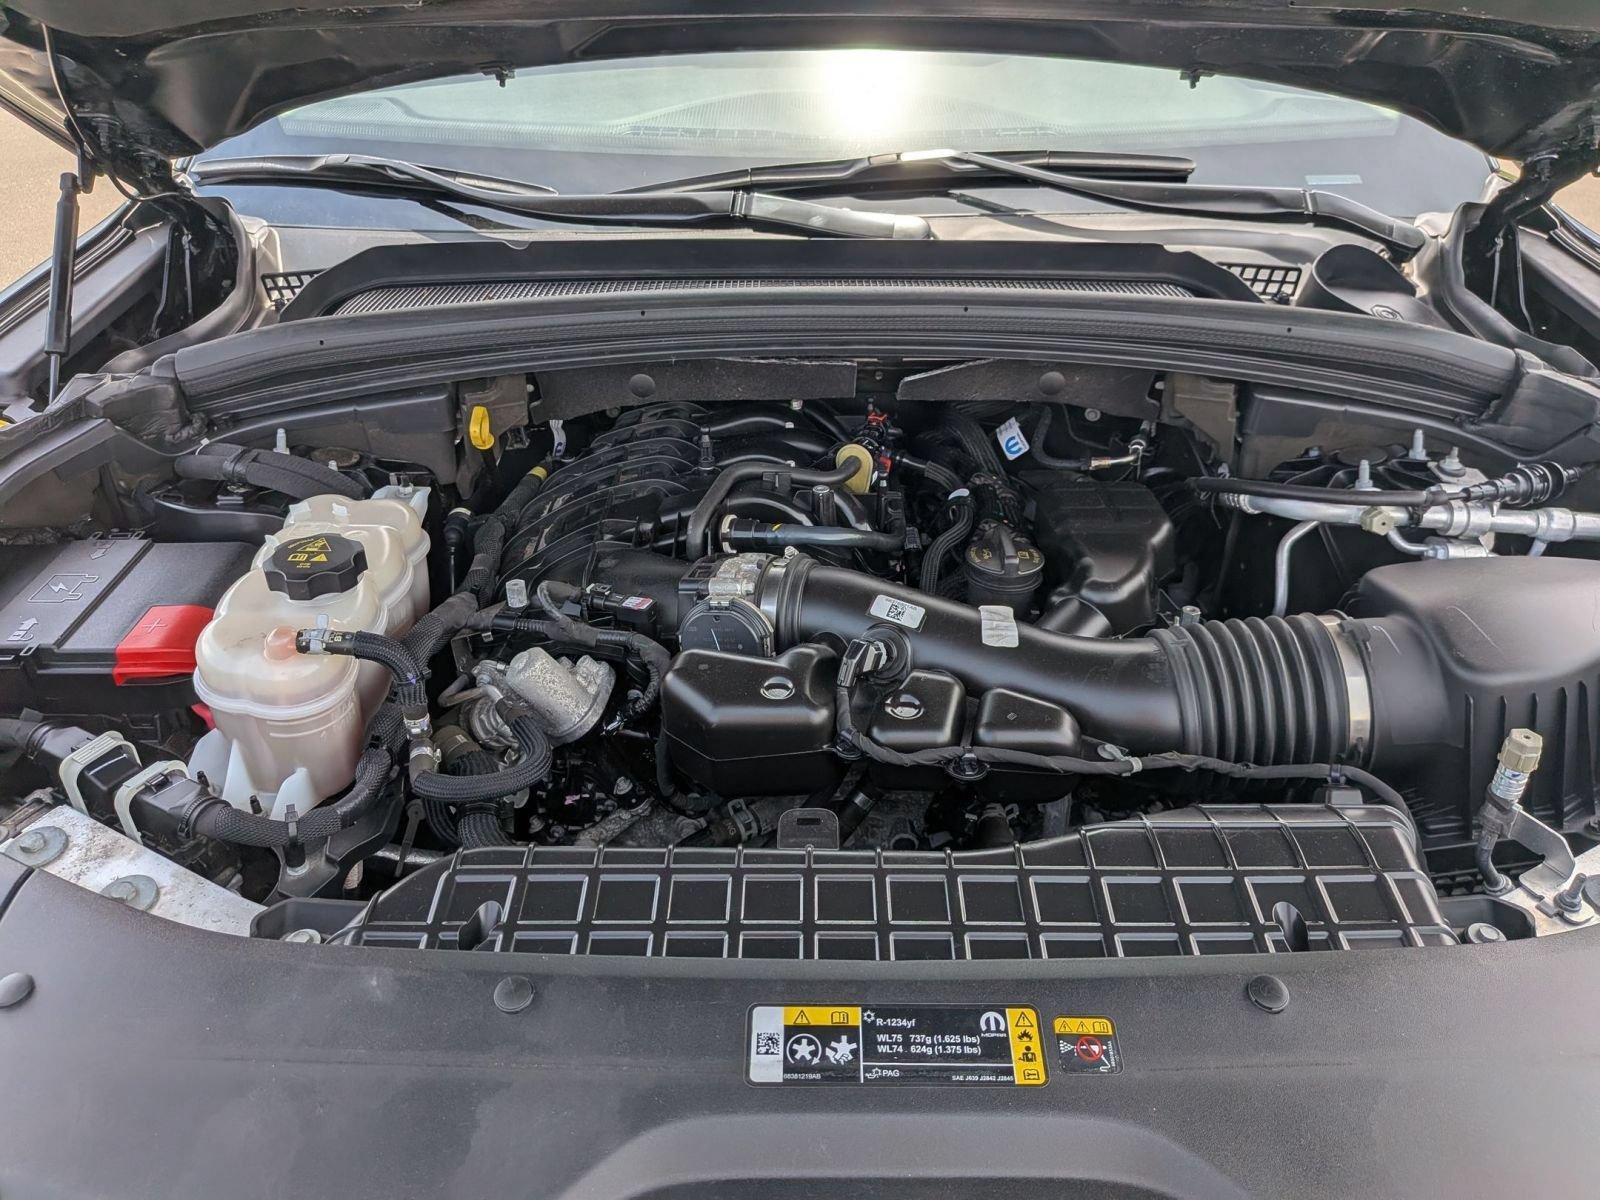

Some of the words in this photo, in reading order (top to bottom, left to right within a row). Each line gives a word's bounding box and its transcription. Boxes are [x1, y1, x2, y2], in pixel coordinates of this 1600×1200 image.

[876, 1018, 916, 1029] R-1234yf
[877, 1034, 903, 1043] WL75
[909, 1034, 932, 1045] 737g
[933, 1034, 961, 1044] (1.625
[962, 1034, 981, 1045] lbs)
[877, 1045, 903, 1053] WL74
[910, 1045, 933, 1055] 624g
[934, 1045, 963, 1055] (1.375
[963, 1045, 982, 1056] lbs)
[882, 1069, 900, 1077] PAG
